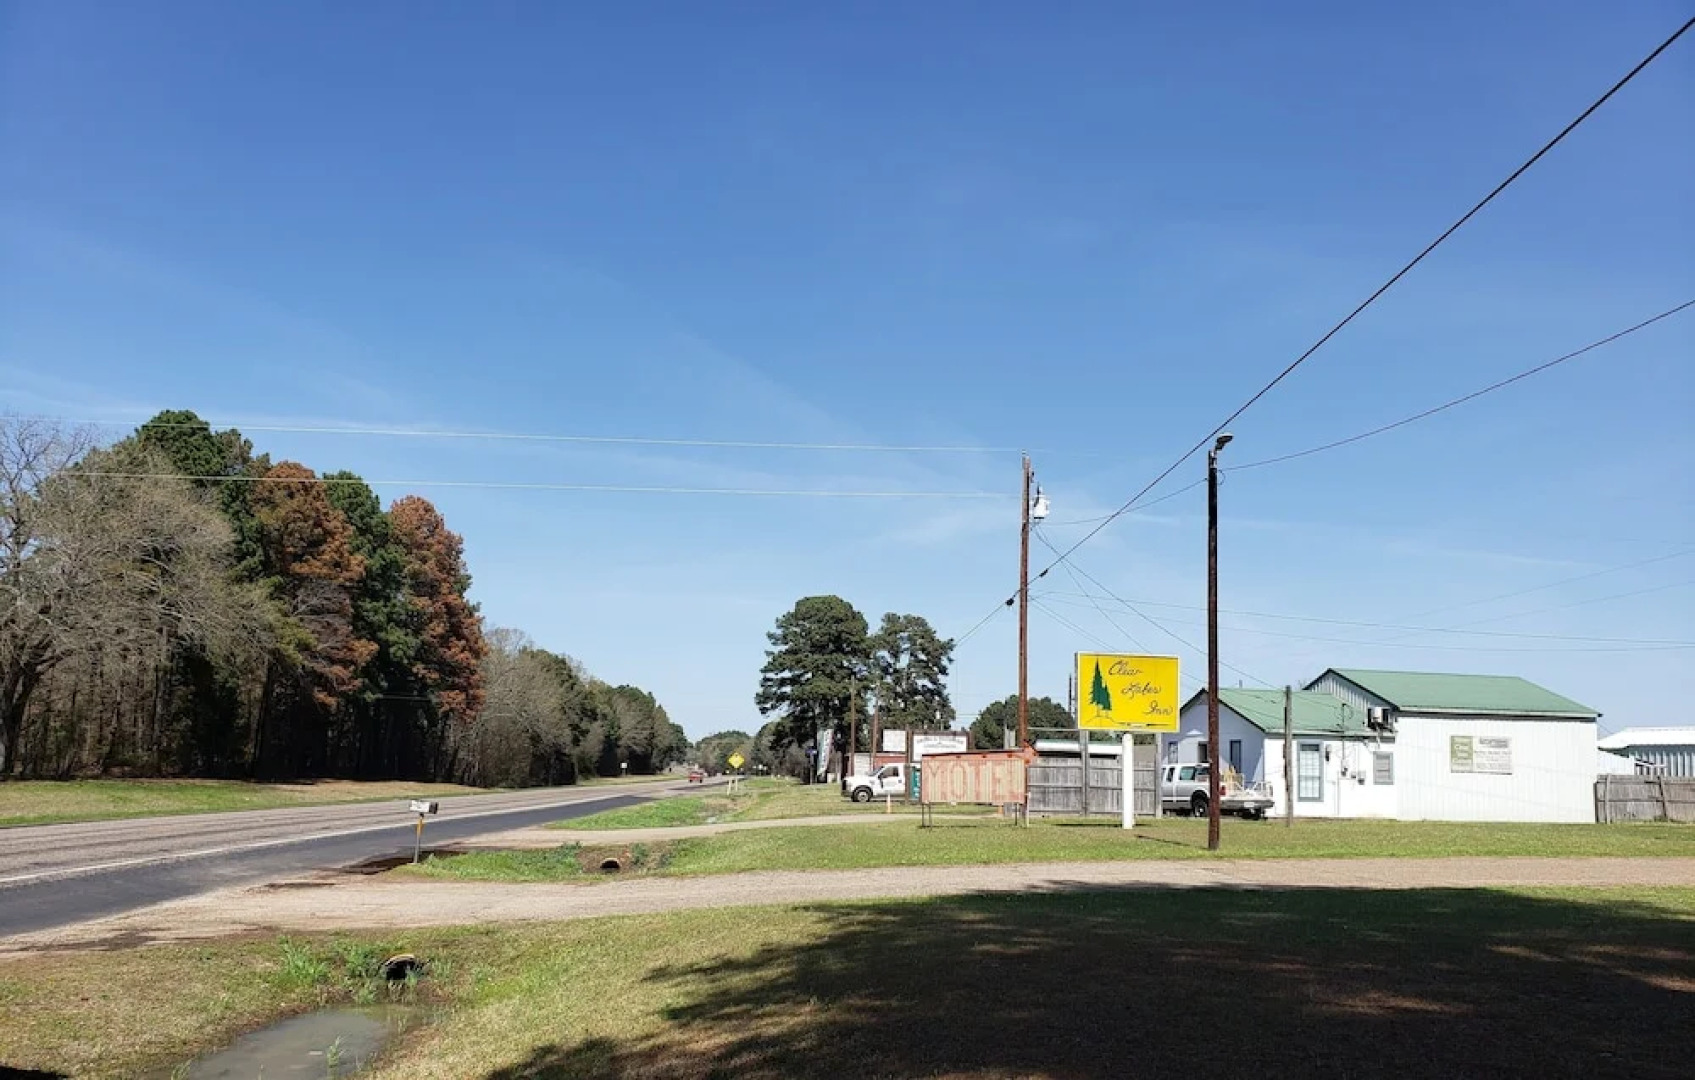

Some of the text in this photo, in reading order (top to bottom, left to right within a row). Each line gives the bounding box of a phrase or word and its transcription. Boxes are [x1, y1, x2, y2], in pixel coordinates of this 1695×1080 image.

[1108, 660, 1143, 676] Clear
[1121, 682, 1162, 700] Lakes
[1143, 700, 1174, 716] Inn
[922, 760, 1024, 802] MOTEL
